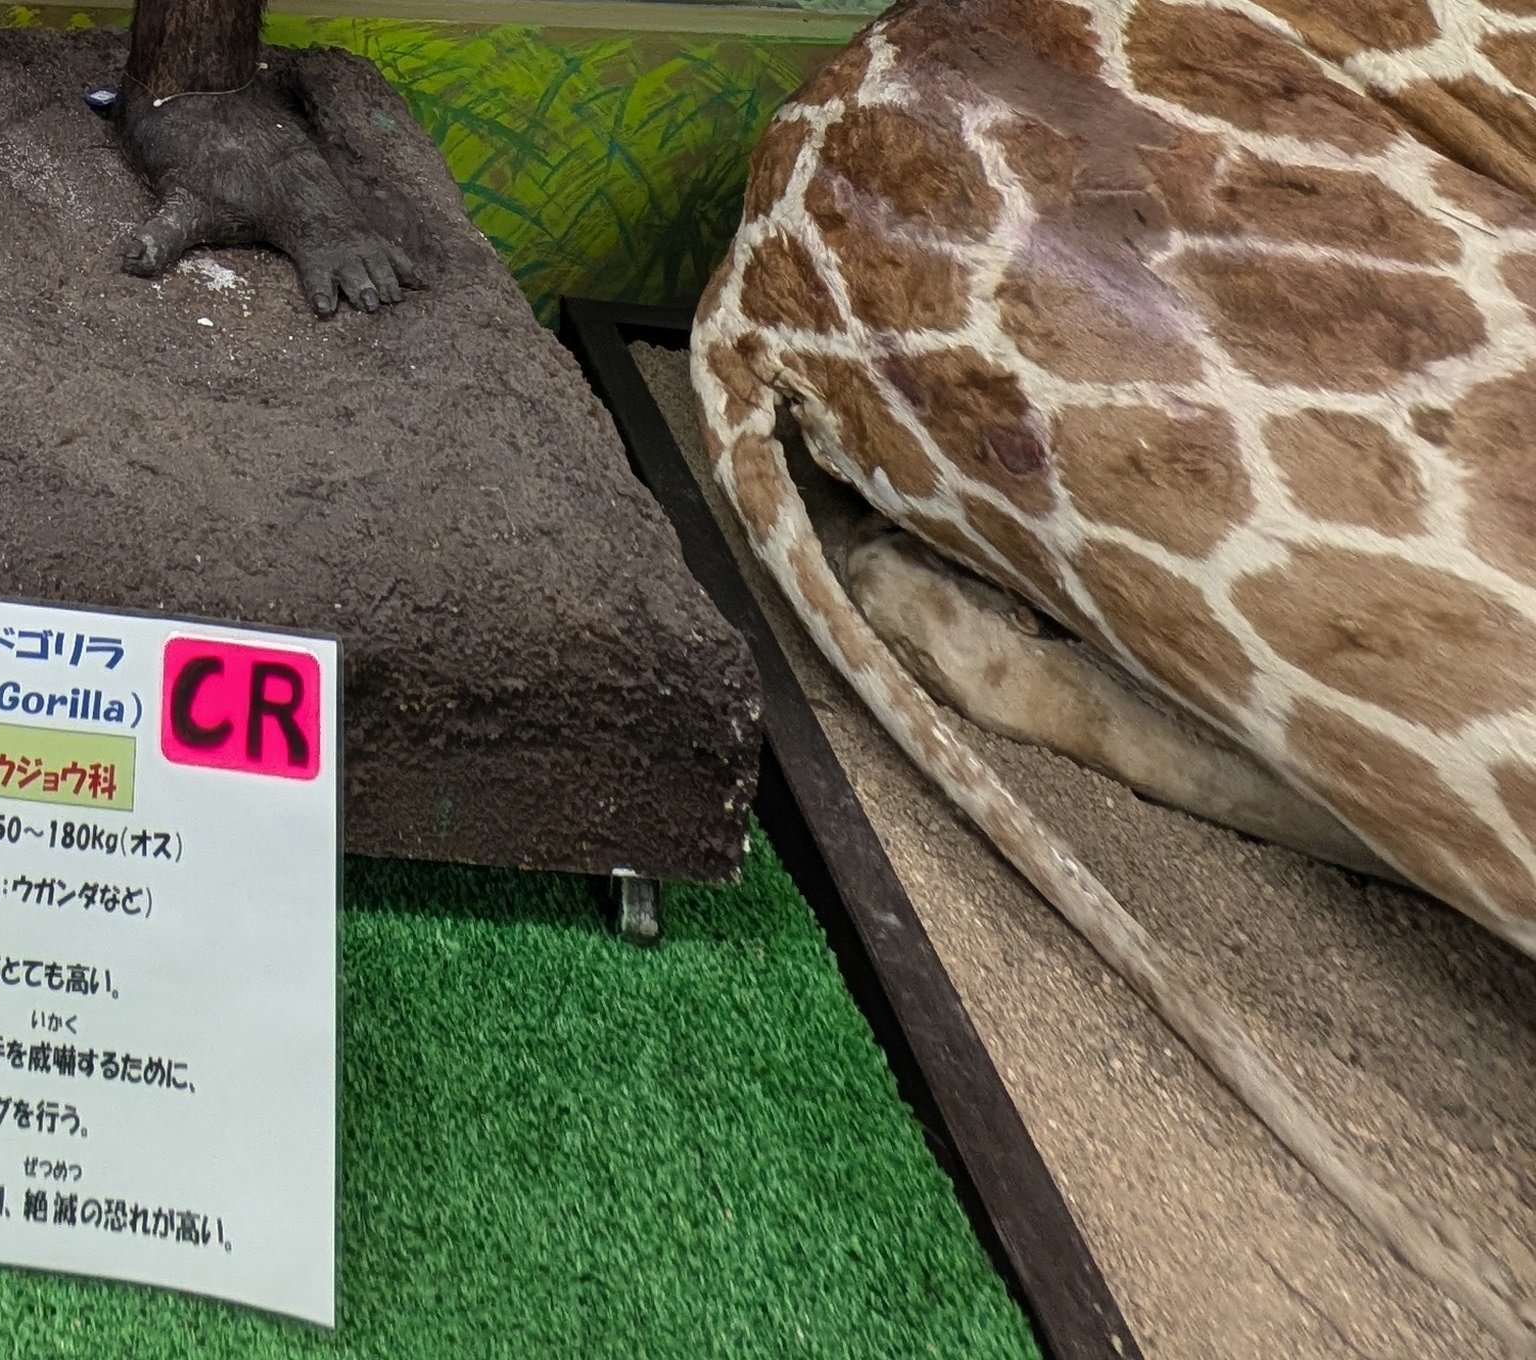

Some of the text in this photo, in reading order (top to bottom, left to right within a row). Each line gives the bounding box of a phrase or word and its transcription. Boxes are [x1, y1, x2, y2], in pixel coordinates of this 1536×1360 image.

[170, 655, 309, 768] CR
[31, 1009, 77, 1034] いかく
